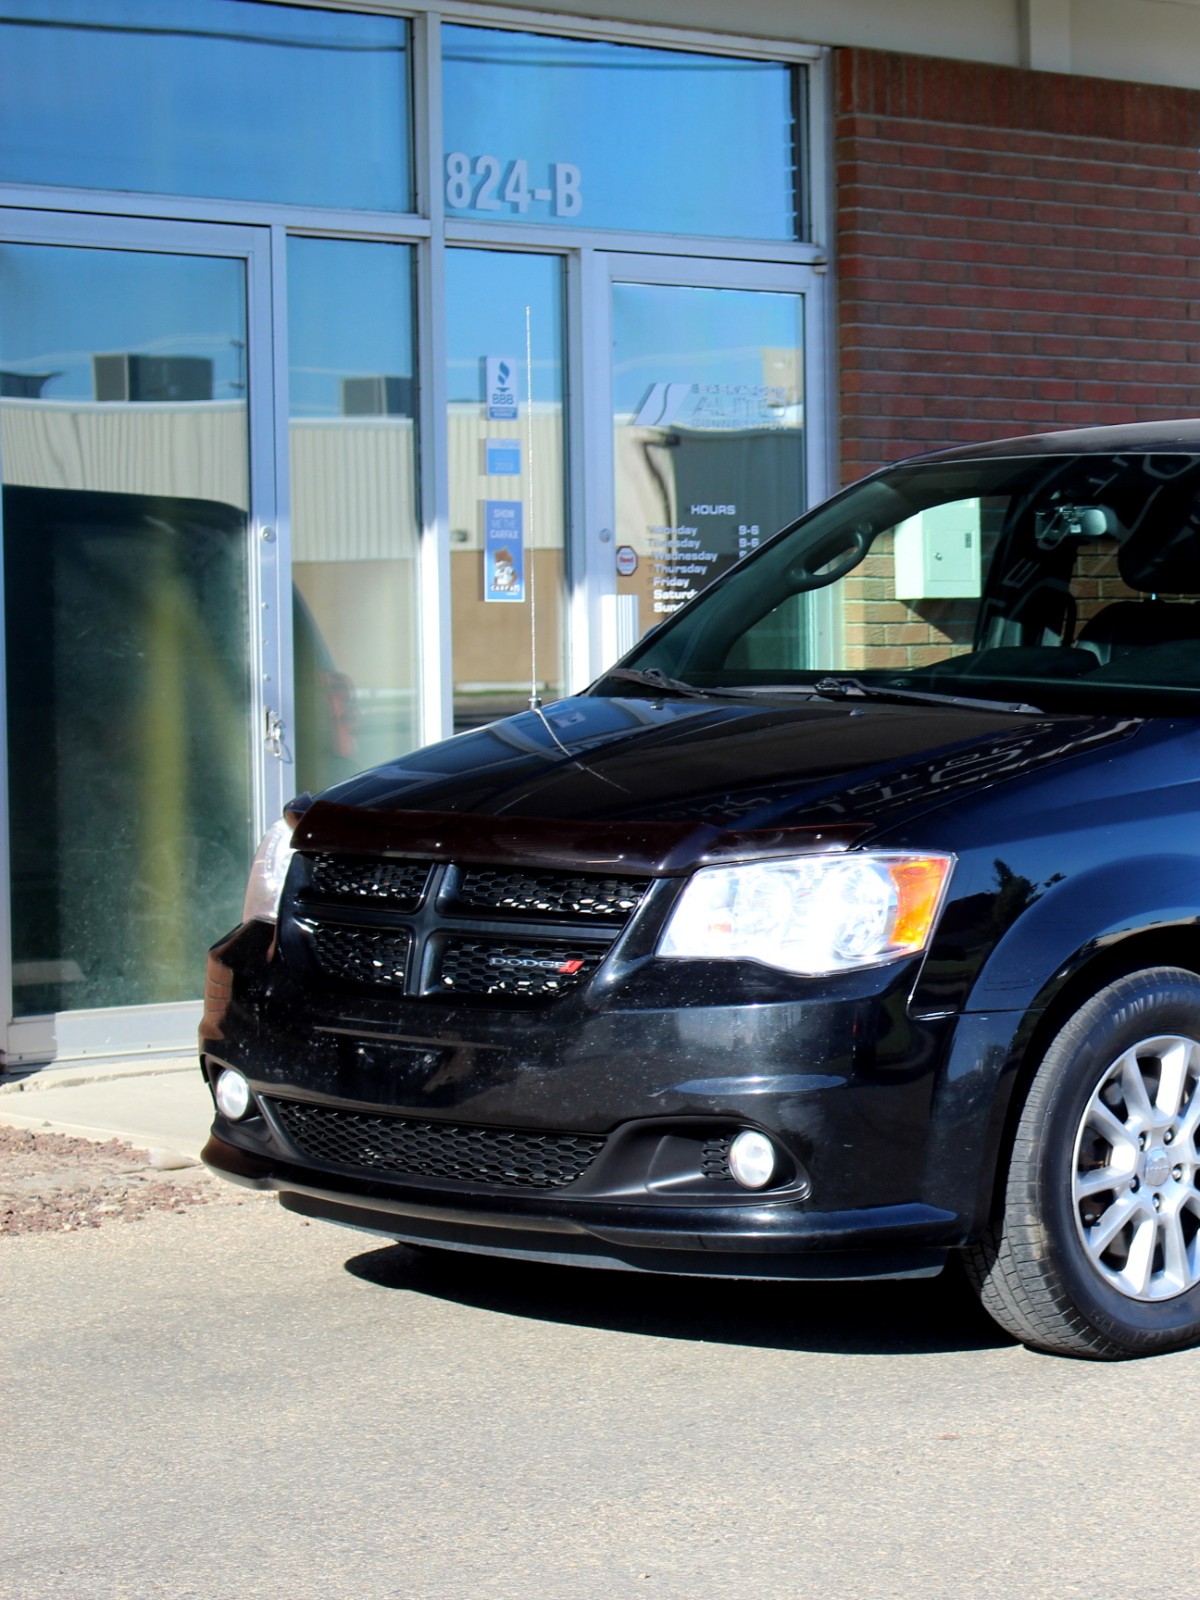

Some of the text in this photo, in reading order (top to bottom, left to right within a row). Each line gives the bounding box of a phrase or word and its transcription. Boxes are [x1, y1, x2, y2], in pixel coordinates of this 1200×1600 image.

[446, 151, 583, 217] 824-B
[493, 393, 514, 405] BBB
[696, 396, 786, 417] AUTO
[690, 504, 737, 515] HOURS
[490, 529, 520, 539] CARFAX
[652, 524, 760, 537] Monday 9-6
[652, 537, 760, 550] Tuesday 9-6
[652, 551, 718, 563] Wednesday
[653, 564, 708, 576] Thursday
[653, 577, 691, 589] Friday
[652, 588, 699, 600] Saturd
[652, 601, 685, 613] Sund
[489, 957, 571, 970] DODGE
